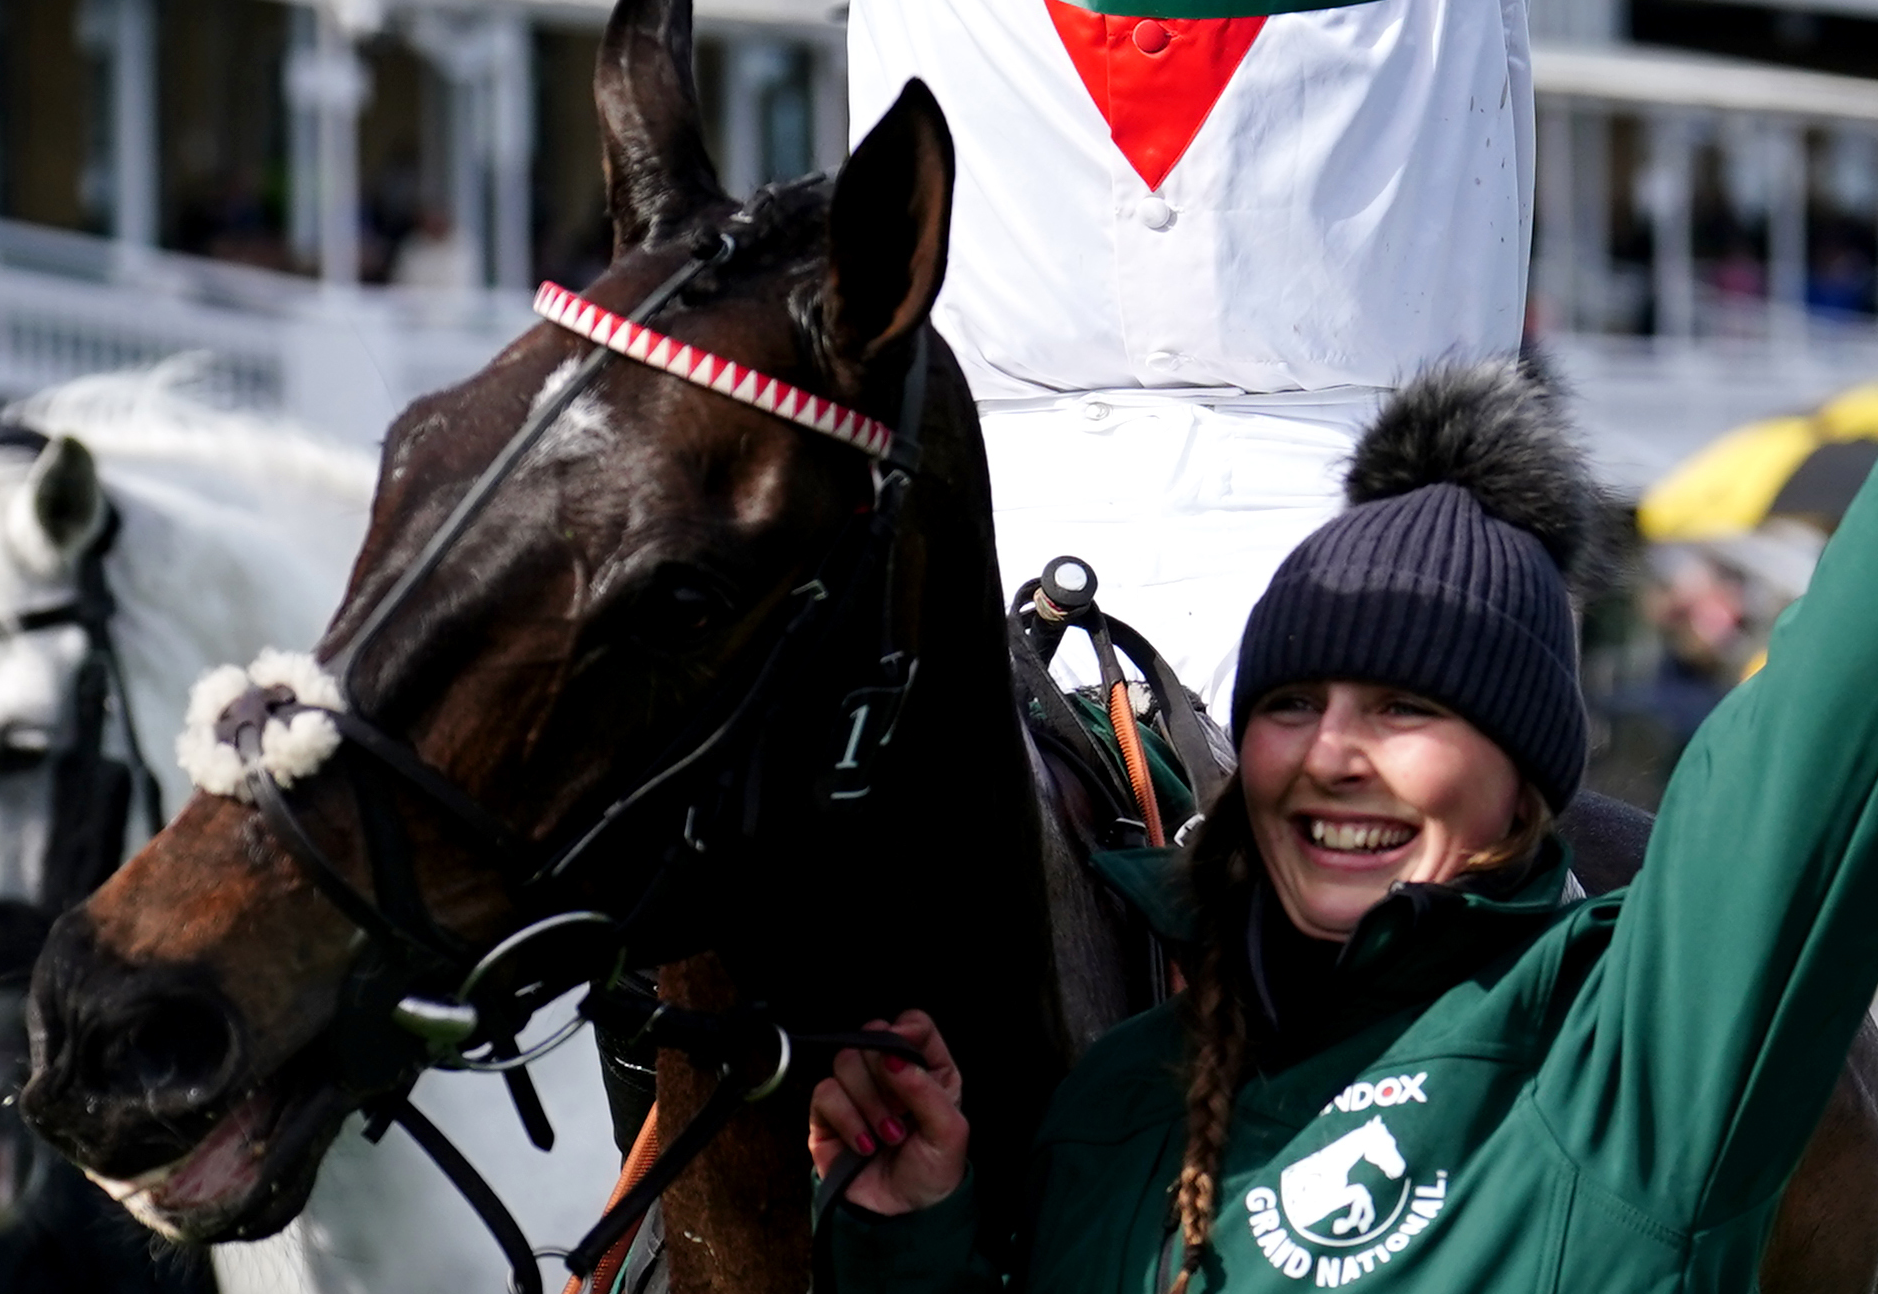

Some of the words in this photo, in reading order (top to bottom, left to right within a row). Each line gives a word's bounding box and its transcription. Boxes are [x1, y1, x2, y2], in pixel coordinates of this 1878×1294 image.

[835, 705, 869, 769] 1
[1319, 1071, 1428, 1117] NDOX
[1246, 1186, 1312, 1279] GRAND
[1316, 1179, 1446, 1288] NATIONAL
